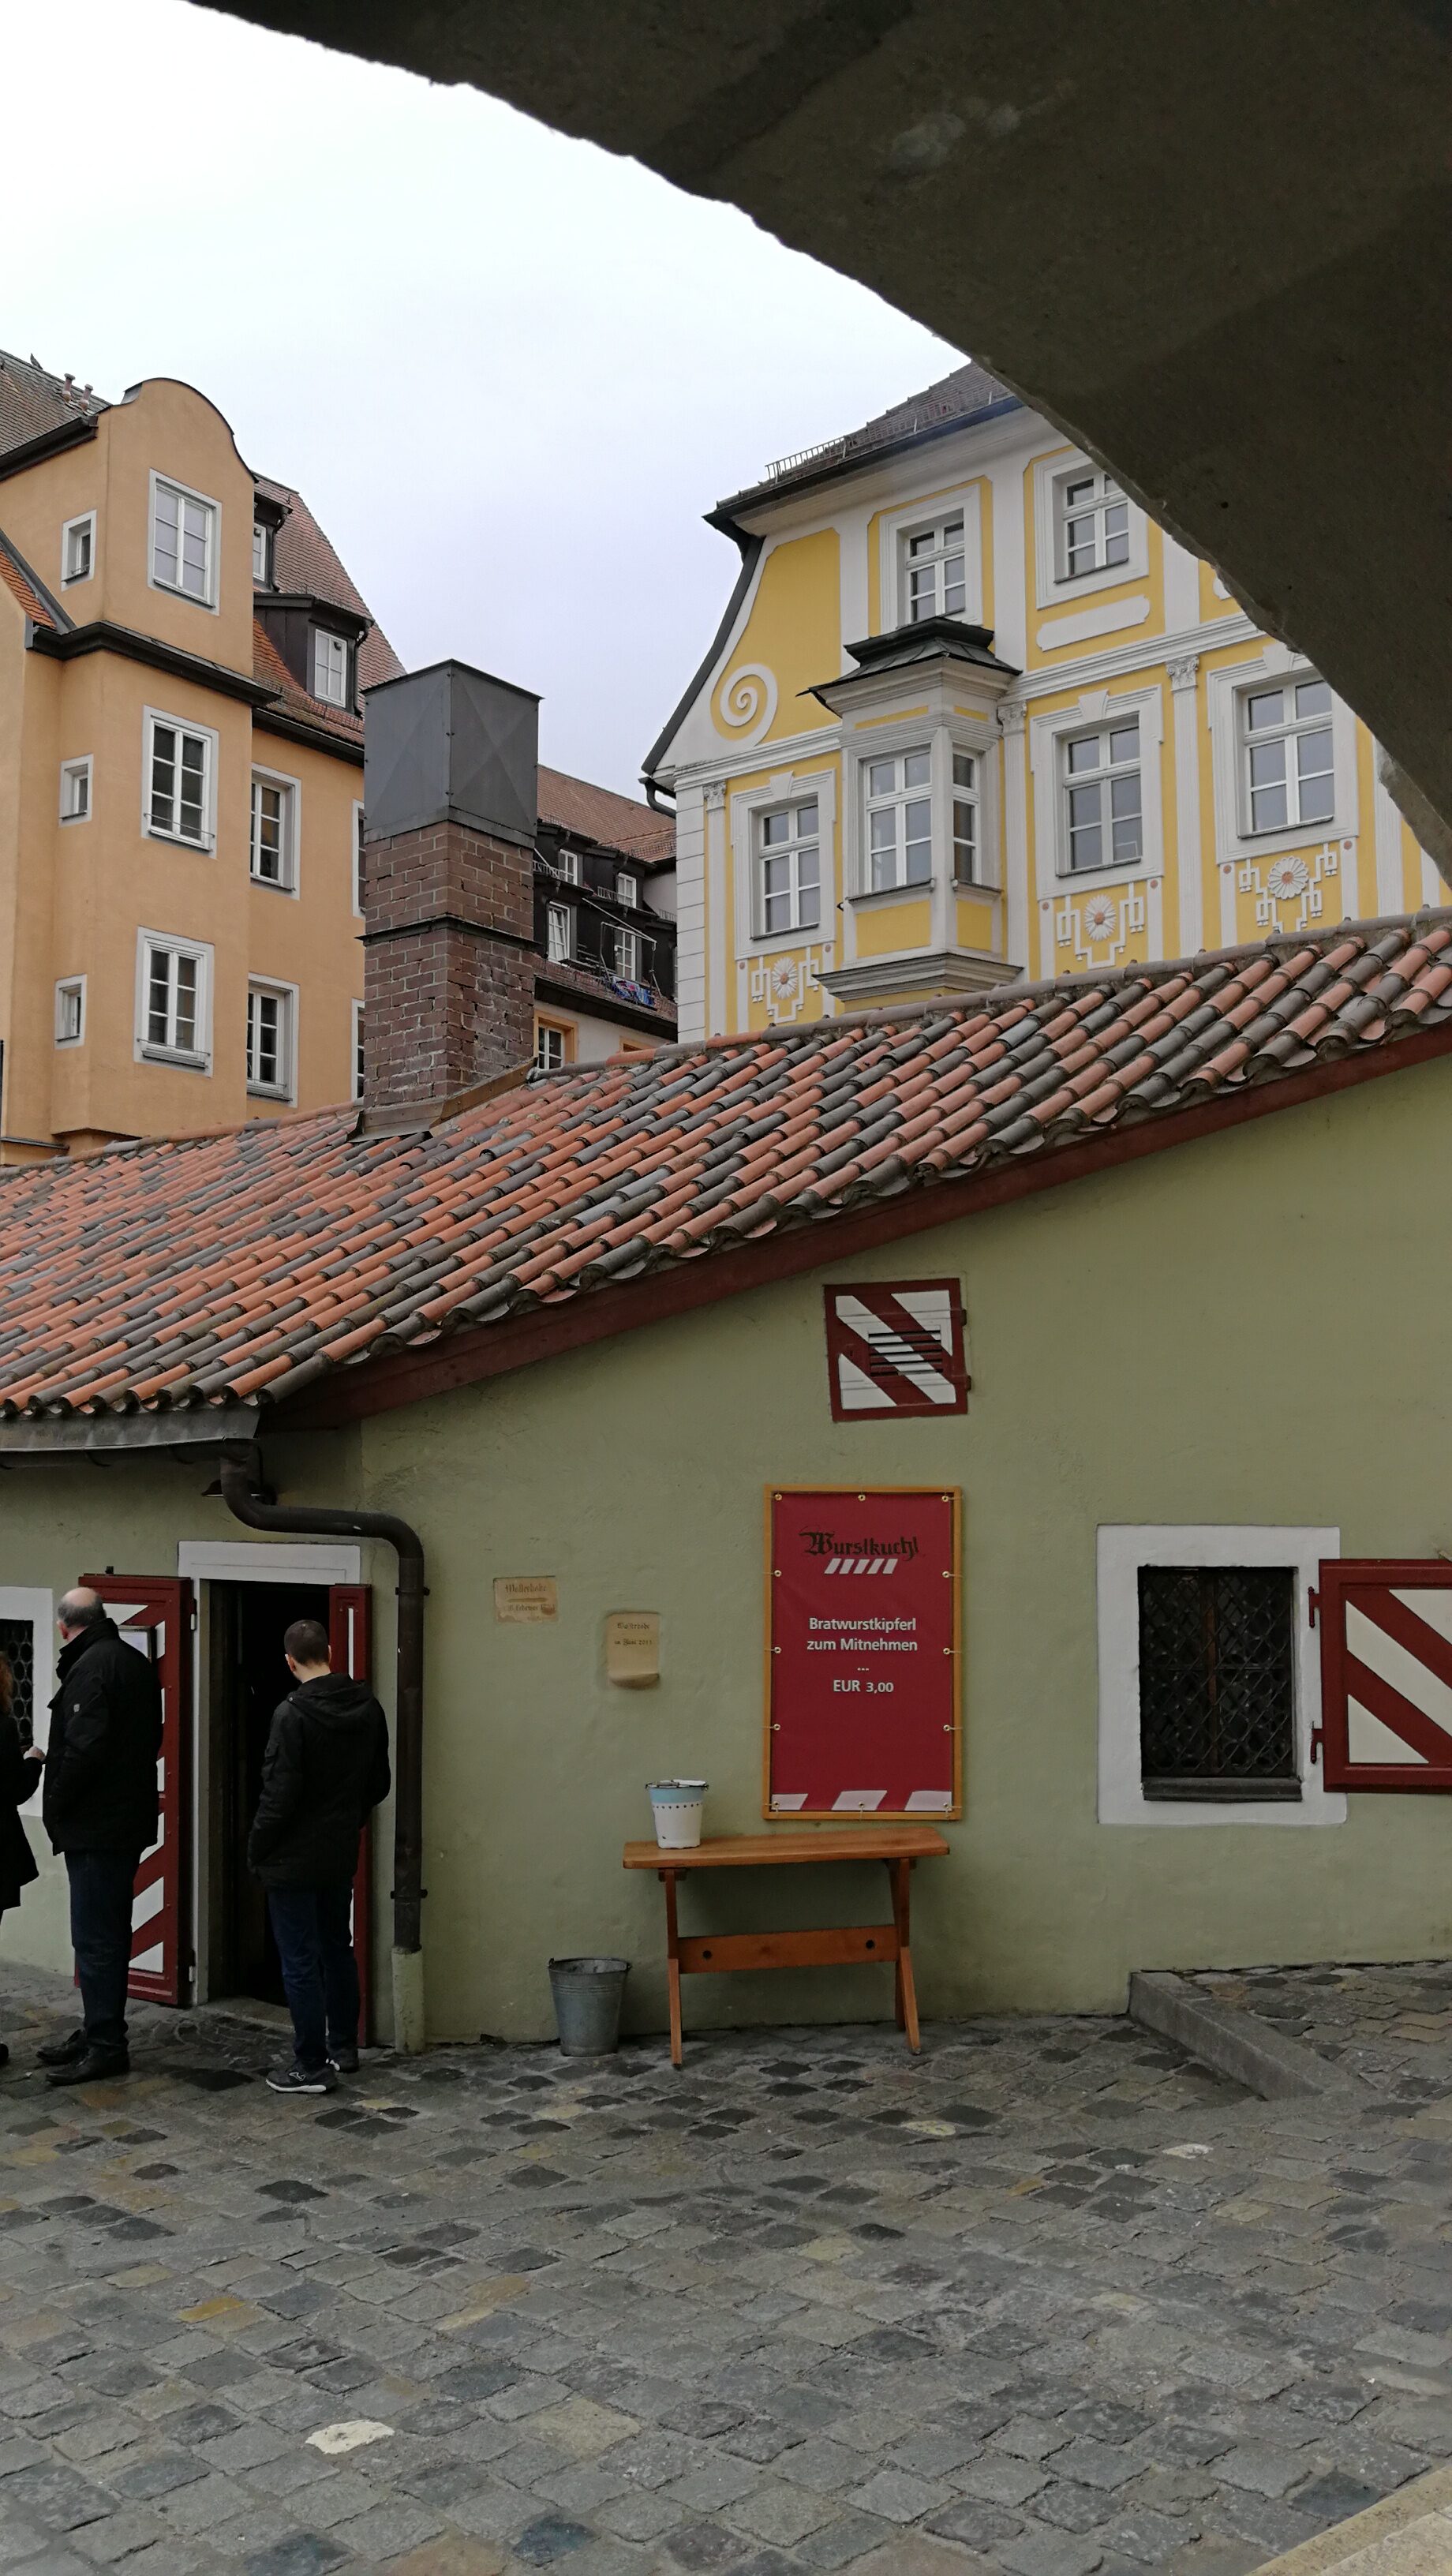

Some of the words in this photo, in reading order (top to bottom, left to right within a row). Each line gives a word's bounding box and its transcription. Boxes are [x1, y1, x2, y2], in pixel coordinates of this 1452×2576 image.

[809, 1617, 916, 1634] Bratwurstkipferl
[806, 1640, 836, 1650] zum
[840, 1638, 918, 1651] Mitnehmen
[833, 1679, 861, 1692] EUR
[866, 1682, 894, 1694] 3,00
